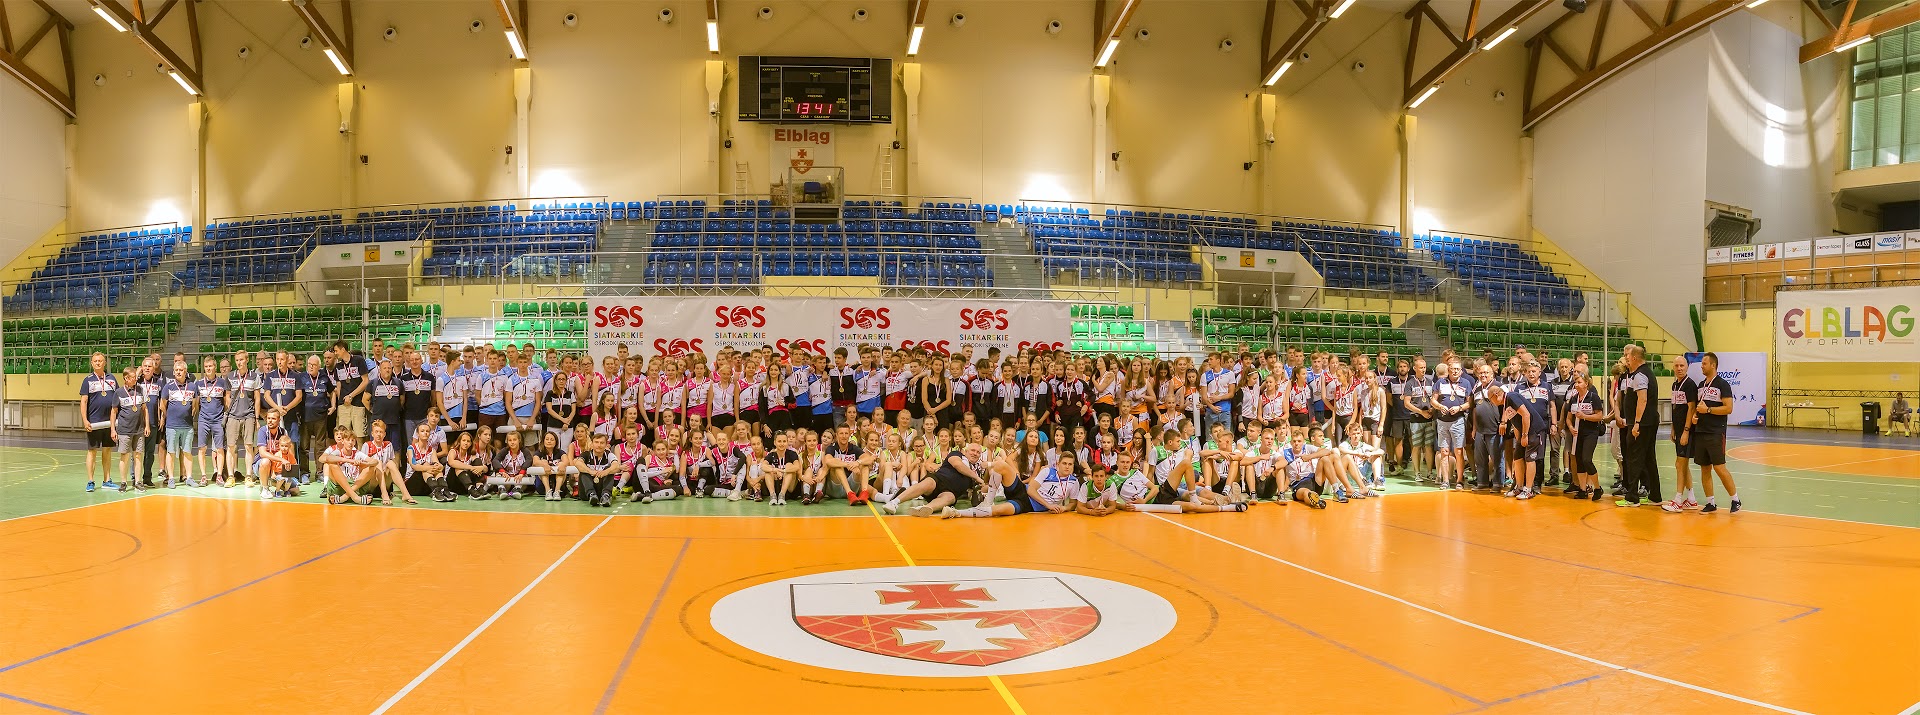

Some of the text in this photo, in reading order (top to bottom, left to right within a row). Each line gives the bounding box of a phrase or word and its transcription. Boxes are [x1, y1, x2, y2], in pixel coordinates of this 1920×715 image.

[775, 129, 830, 145] Elbląg
[1855, 239, 1870, 248] GLASS
[594, 306, 644, 328] SOS
[715, 306, 766, 328] SOS
[840, 307, 891, 329] SOS
[960, 308, 1009, 331] SOS
[839, 333, 891, 341] SIATKARSKIE
[1806, 338, 1875, 346] FORMIE
[1046, 484, 1058, 497] 15
